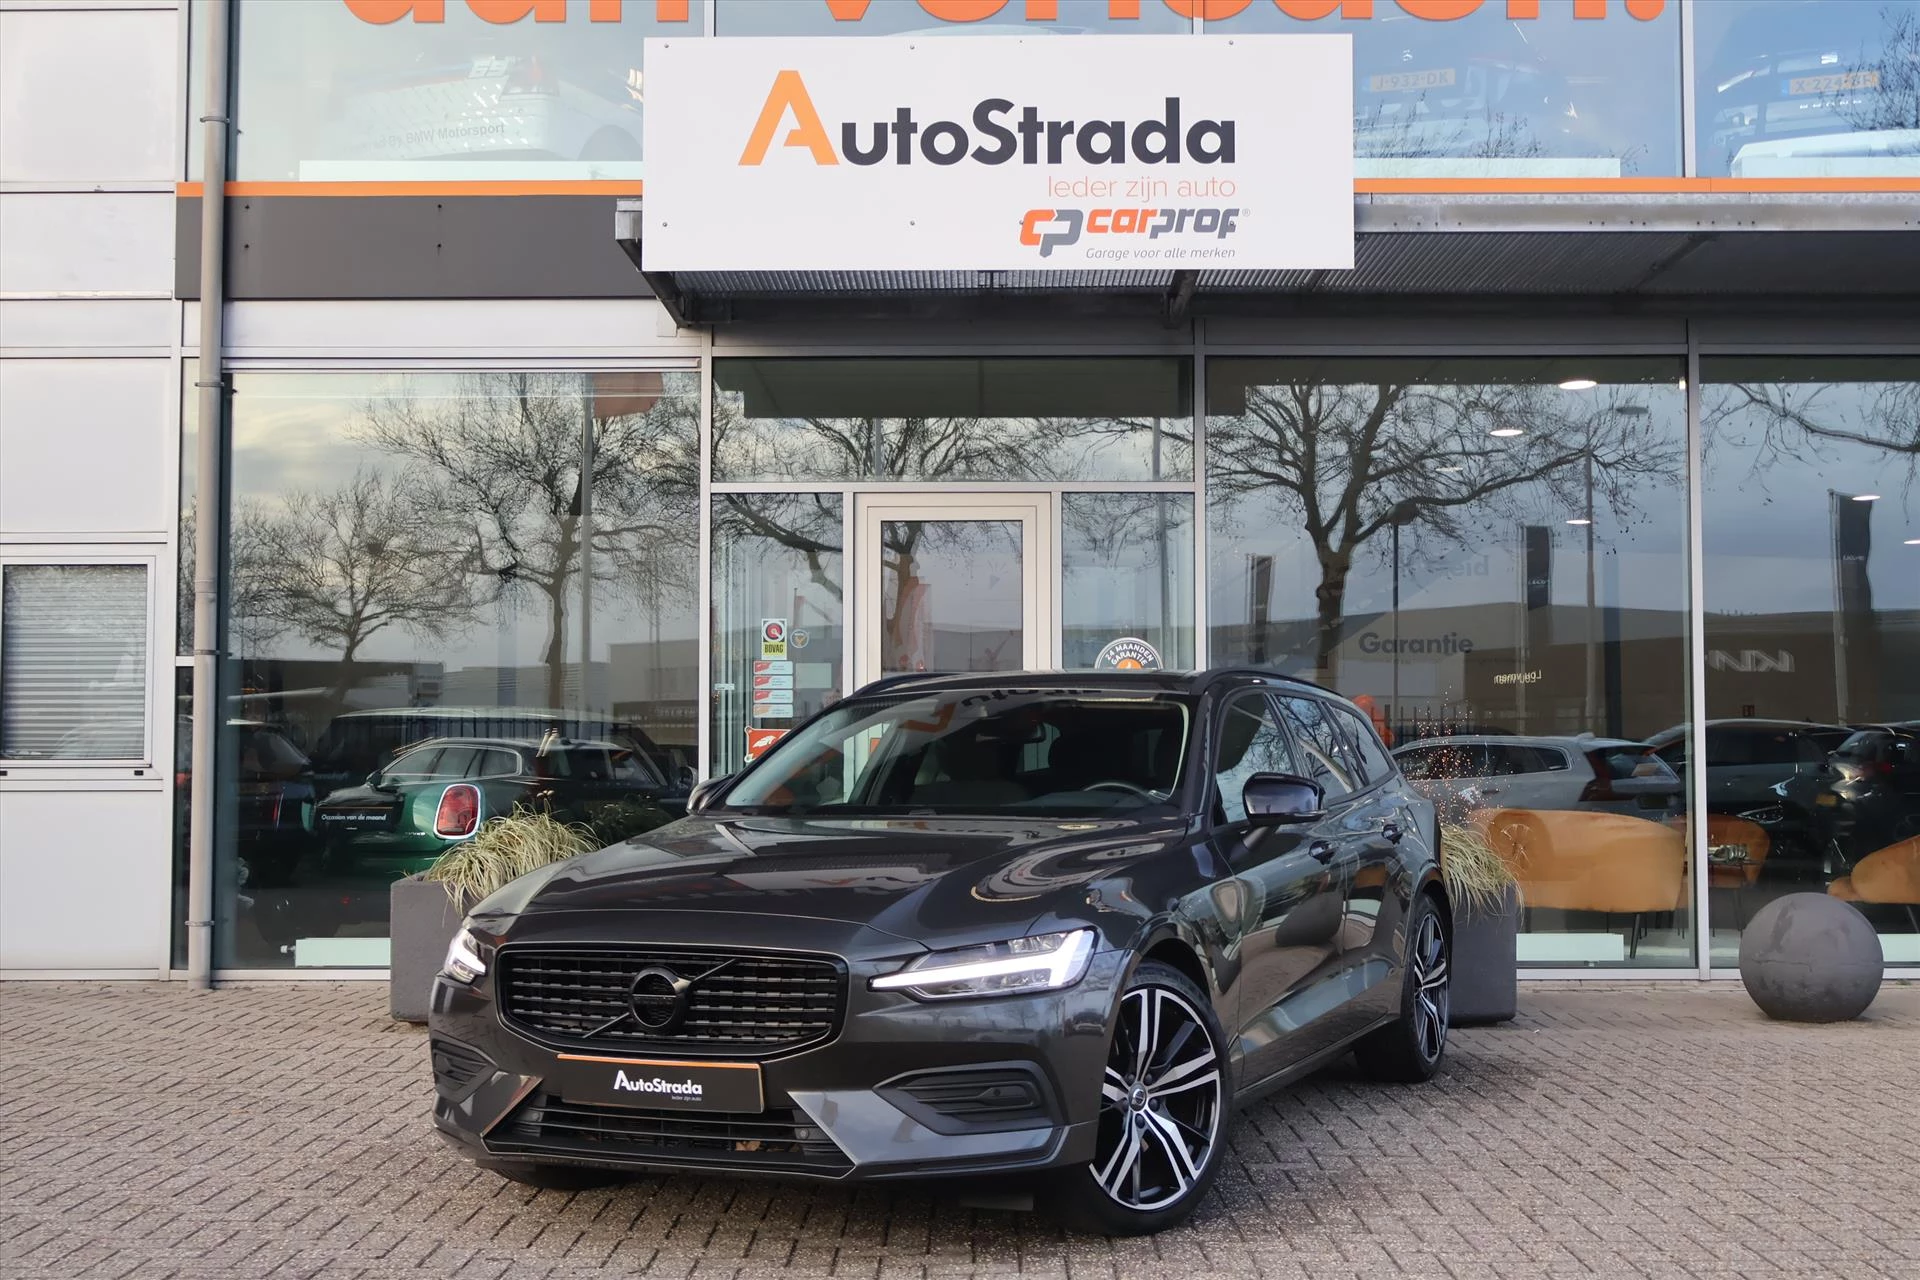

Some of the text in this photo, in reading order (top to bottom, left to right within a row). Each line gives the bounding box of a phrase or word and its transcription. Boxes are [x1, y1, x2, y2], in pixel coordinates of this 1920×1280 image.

[738, 70, 1236, 166] AutoStrada
[406, 129, 434, 144] BMW
[438, 122, 505, 140] Motorsport
[1048, 176, 1236, 202] Ieder zijn auto
[1086, 247, 1236, 261] Garage voor alle merken
[764, 643, 784, 654] BOVAG
[1104, 643, 1155, 662] 24 MAANDEN
[1358, 631, 1474, 655] Garantie
[1110, 650, 1148, 666] GARANTIE
[357, 813, 366, 821] de
[366, 813, 387, 821] maand
[613, 1069, 703, 1095] AutoStrada
